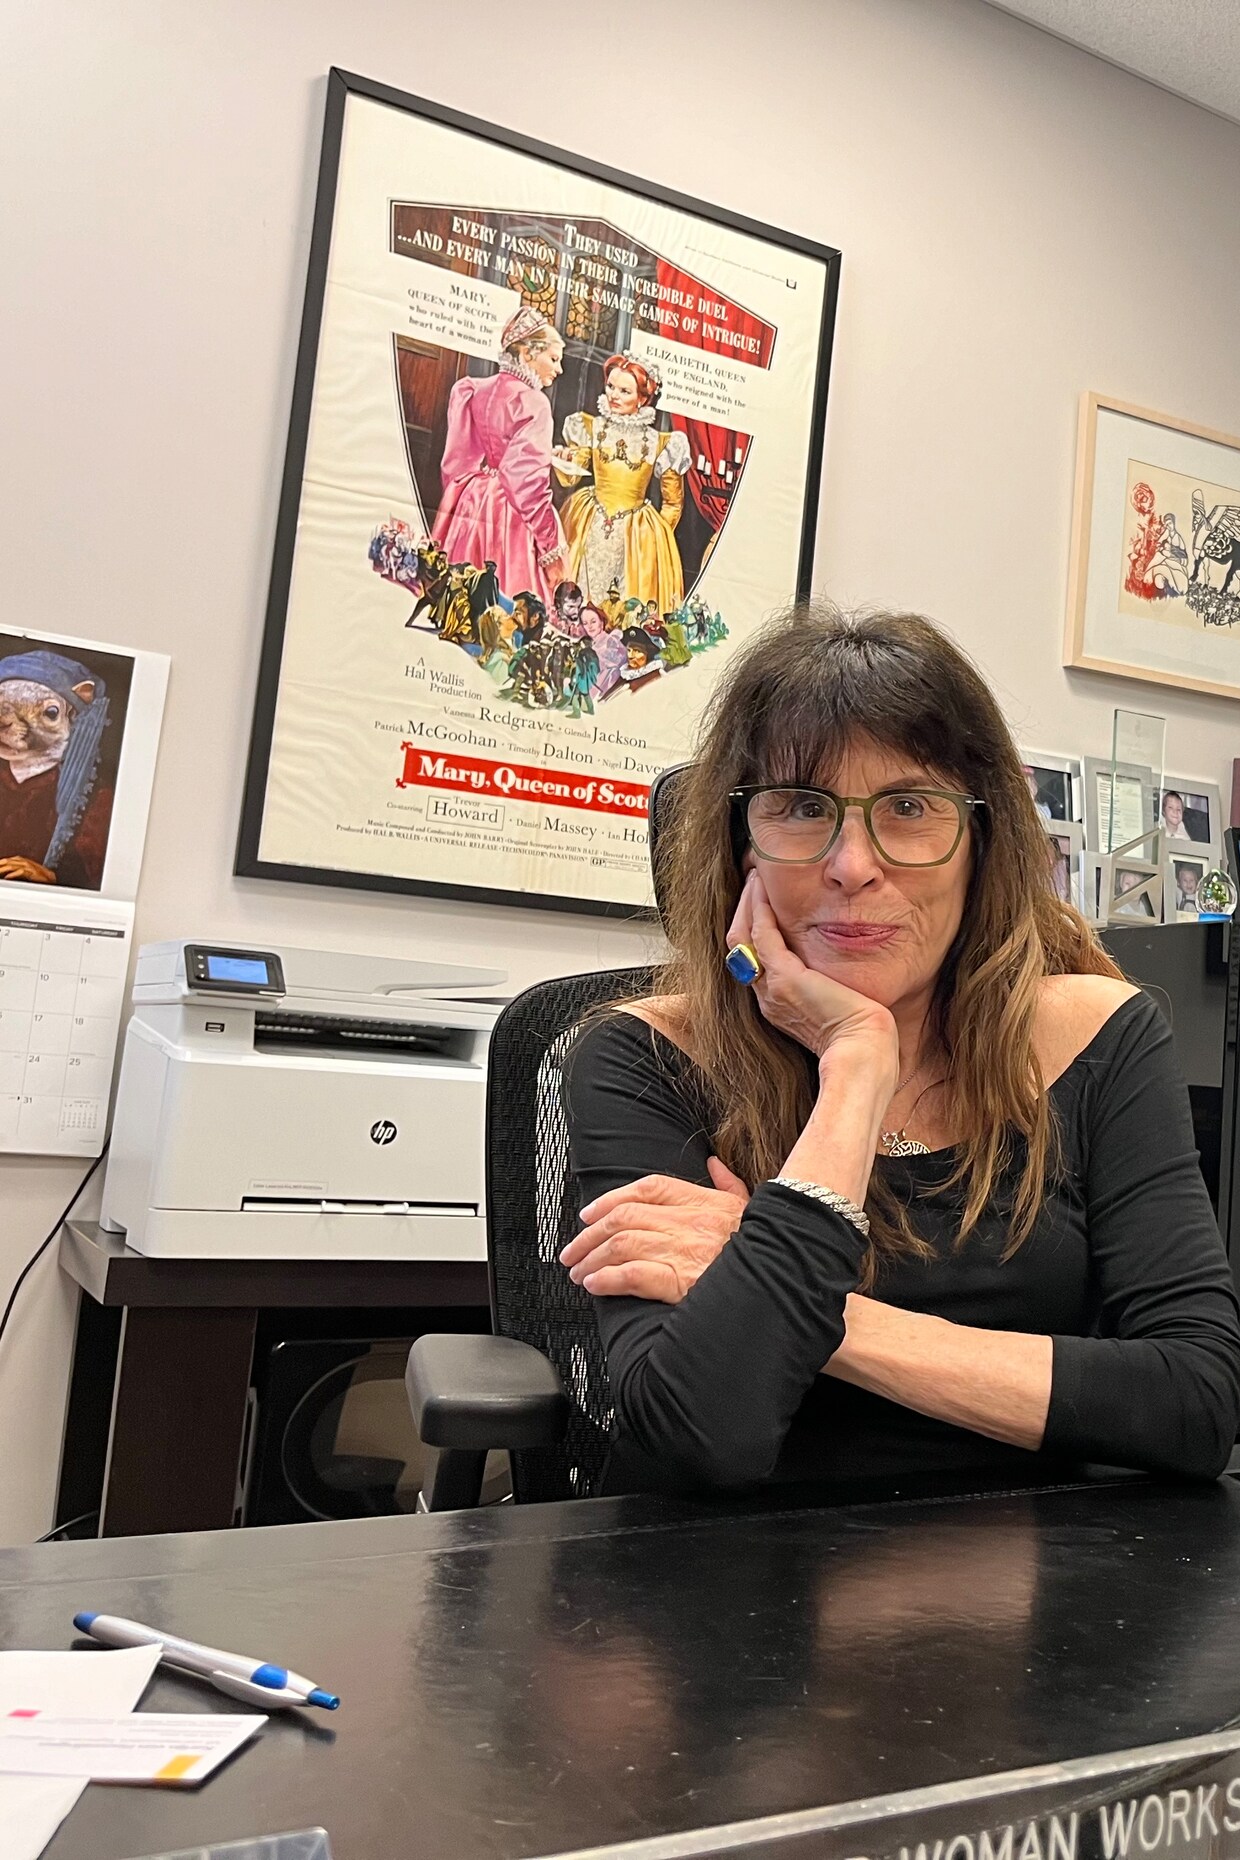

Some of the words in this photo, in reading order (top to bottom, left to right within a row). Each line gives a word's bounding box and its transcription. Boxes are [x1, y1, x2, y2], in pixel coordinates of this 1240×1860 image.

[606, 246, 638, 268] USED
[452, 216, 497, 244] EVERY
[501, 232, 556, 264] PASSION
[561, 252, 576, 270] IN
[579, 259, 618, 285] THEIR
[623, 274, 693, 310] INCREDIBLE
[698, 298, 728, 320] DUEL
[398, 229, 443, 251] ...AND
[447, 240, 491, 267] EVERY
[494, 256, 525, 277] MAN
[530, 266, 545, 284] IN
[550, 273, 589, 299] THEIR
[592, 288, 635, 314] SAVAGE
[639, 303, 679, 328] GAMES
[683, 316, 698, 334] OF
[702, 323, 760, 354] INTRIGUE!
[408, 289, 445, 306] QUEEN
[449, 301, 462, 310] OF
[409, 305, 427, 315] who
[430, 311, 453, 323] ruled
[457, 319, 475, 330] with
[479, 325, 493, 334] the
[409, 316, 432, 330] heart
[457, 332, 491, 346] woman!
[668, 367, 680, 376] OF
[715, 368, 746, 383] QUEEN
[666, 393, 689, 404] power
[710, 406, 730, 416] man!
[667, 380, 682, 389] who
[685, 386, 714, 399] reigned
[716, 394, 732, 404] with
[734, 399, 746, 408] the
[417, 657, 425, 666] A
[405, 665, 425, 680] Hal
[429, 670, 465, 687] Wallis
[430, 683, 482, 700] Production
[444, 706, 475, 719] Vanessa
[479, 706, 554, 732] Redgrave
[565, 728, 591, 739] Glenda
[592, 727, 647, 748] Jackson
[374, 721, 404, 732] Patrick
[407, 720, 497, 748] McGoohan
[508, 742, 540, 757] Timothy
[543, 743, 593, 764] Dalton
[603, 759, 621, 769] Nigel
[417, 755, 490, 788] Mary,
[494, 767, 570, 793] Queen
[573, 782, 596, 804] of
[453, 796, 481, 807] Trevor
[433, 801, 498, 823] Howard
[516, 819, 541, 829] Daniel
[544, 817, 598, 841] Massey
[608, 831, 620, 840] Ian
[464, 832, 482, 840] JOHN
[592, 857, 606, 866] GP
[4, 929, 10, 937] 2
[45, 933, 51, 941] 3
[40, 973, 49, 981] 10
[34, 1014, 43, 1022] 17
[75, 1017, 84, 1025] 18
[29, 1055, 40, 1063] 24
[69, 1058, 81, 1066] 25
[23, 1096, 33, 1104] 31
[371, 1119, 397, 1145] hp
